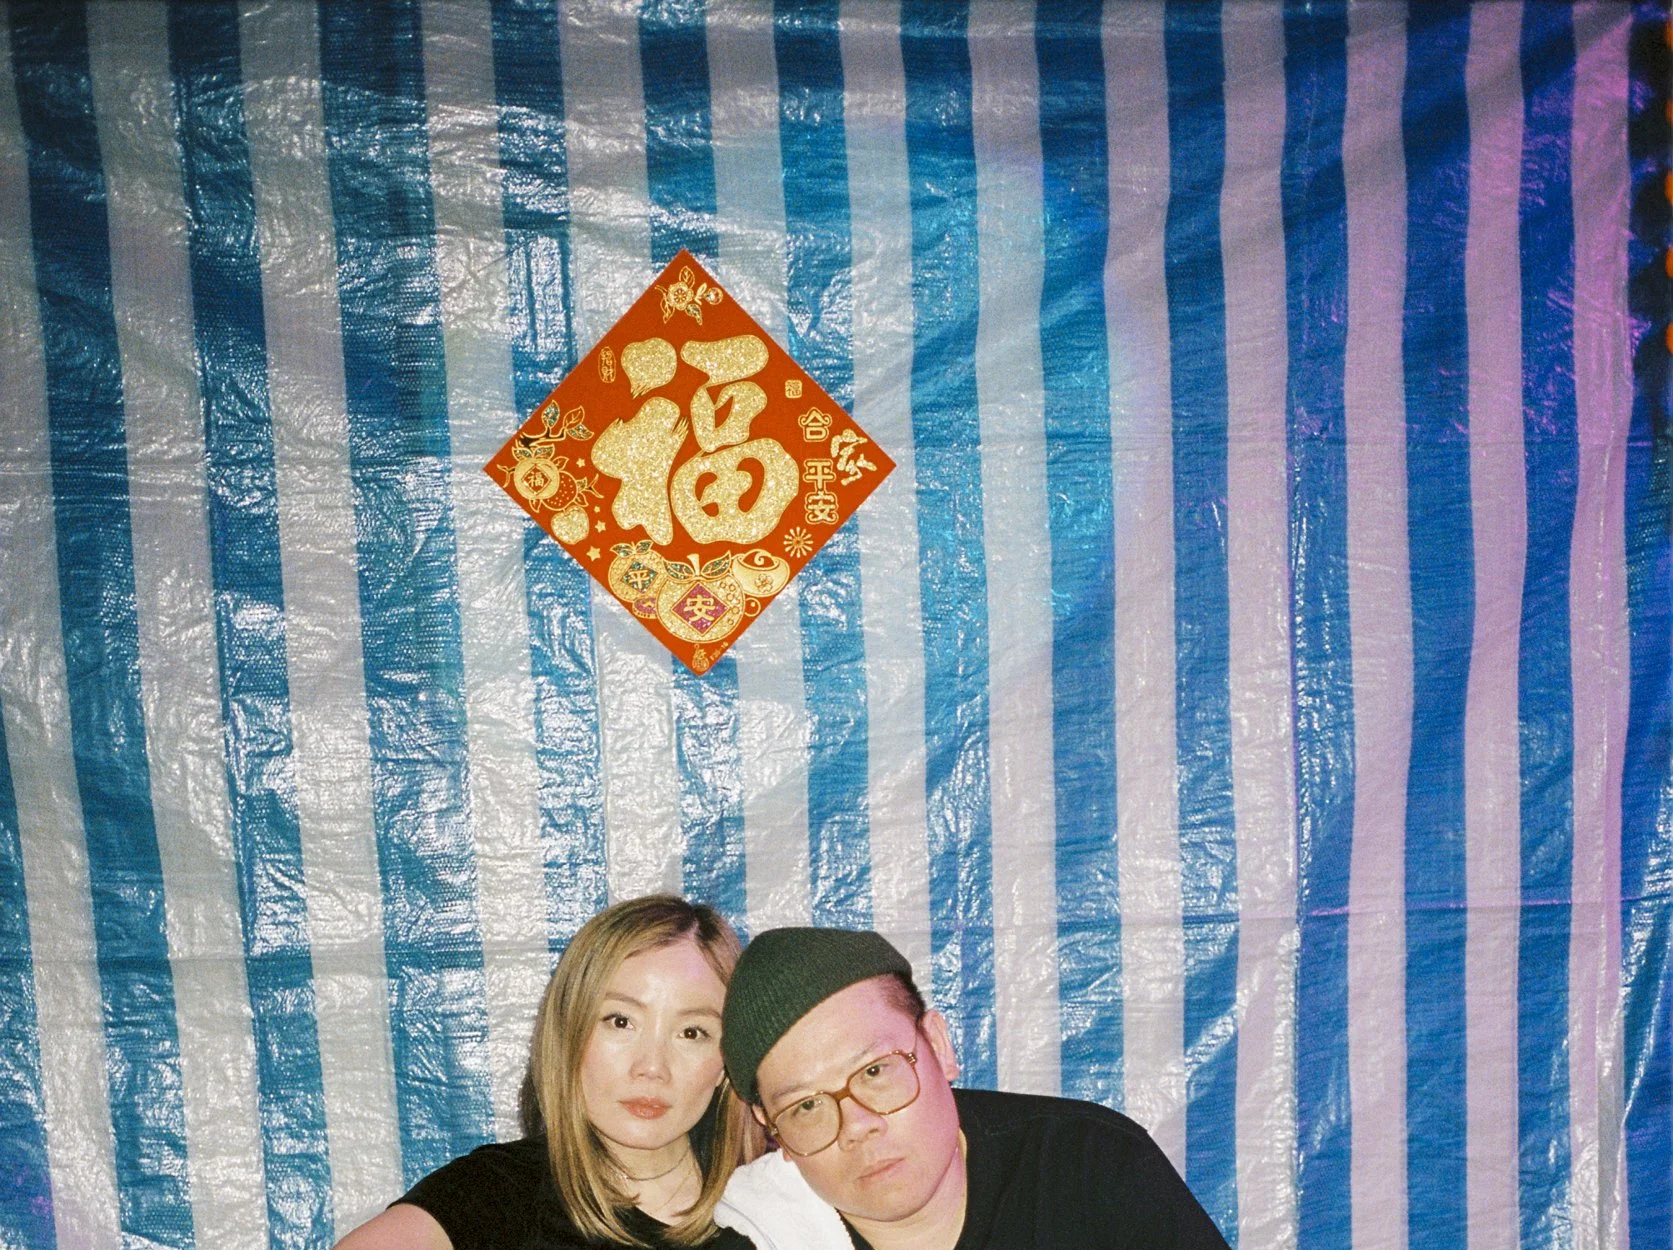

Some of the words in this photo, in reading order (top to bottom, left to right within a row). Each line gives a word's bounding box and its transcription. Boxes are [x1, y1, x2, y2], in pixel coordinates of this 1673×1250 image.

[591, 335, 799, 545] 福
[527, 471, 545, 487] 福
[683, 594, 716, 622] 安
